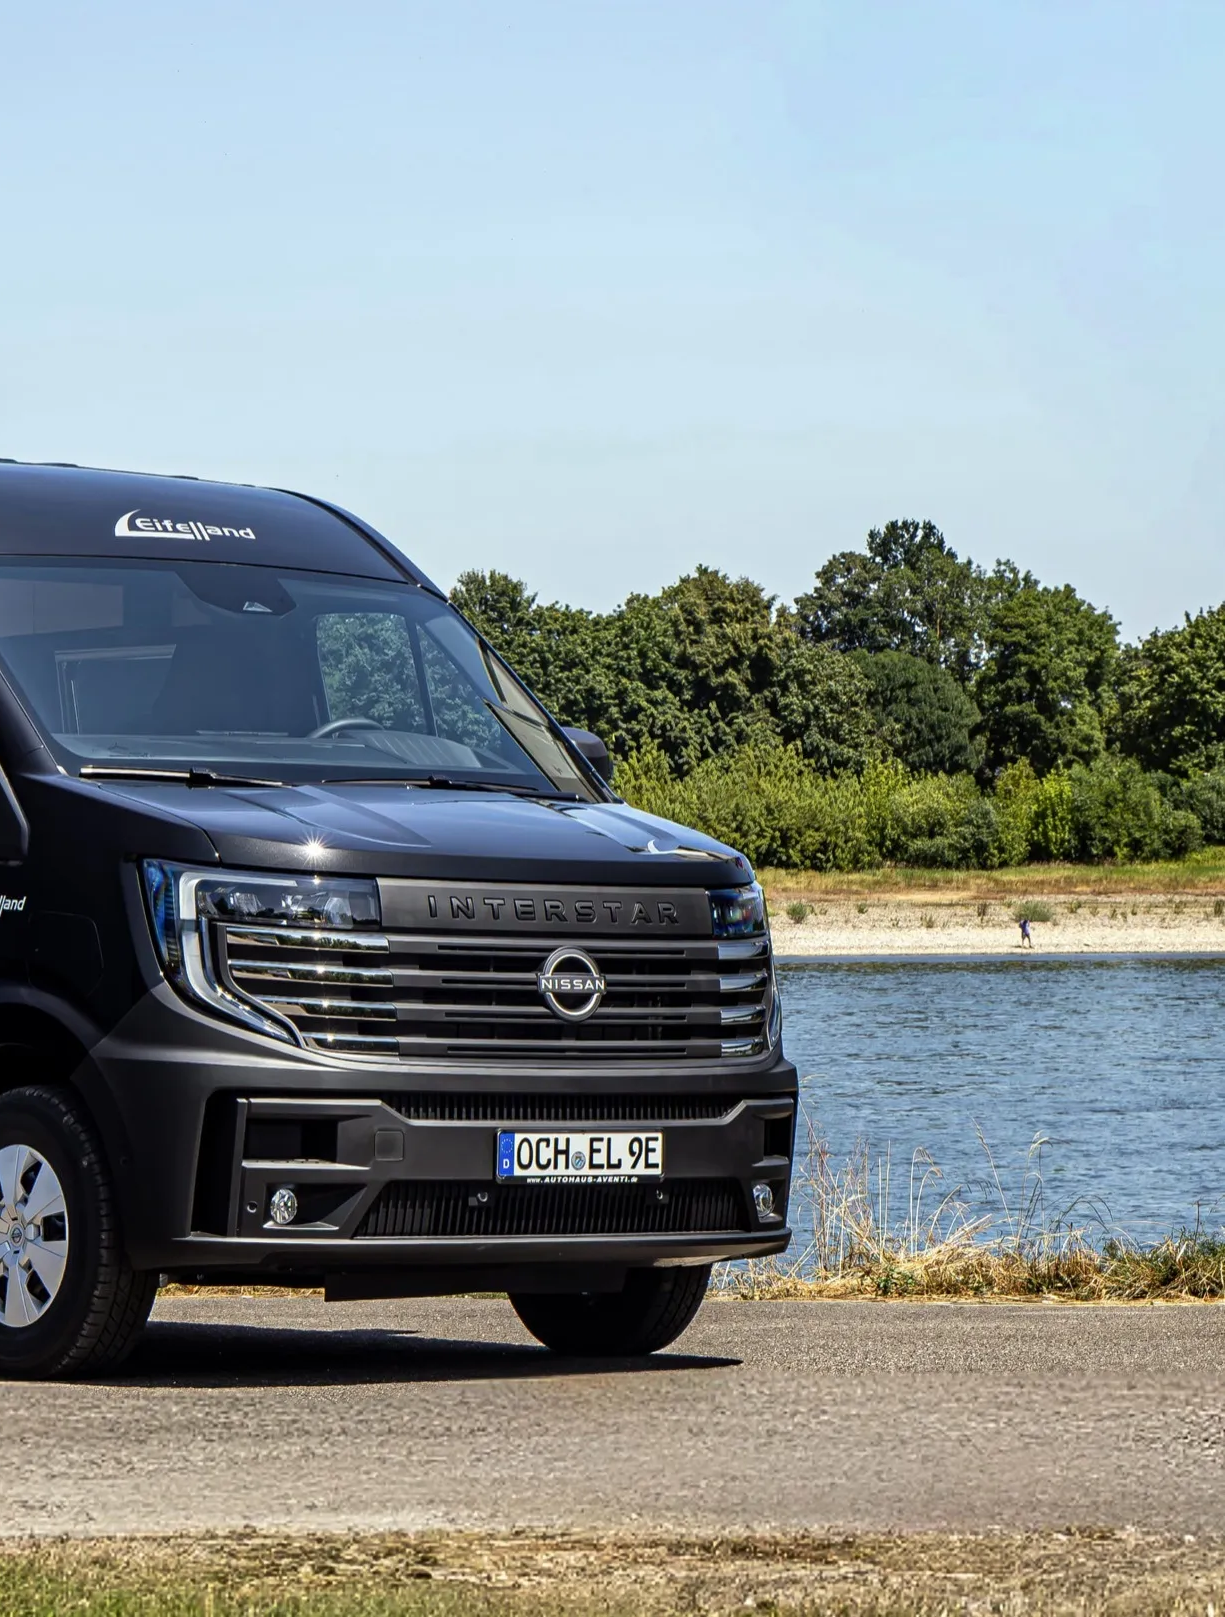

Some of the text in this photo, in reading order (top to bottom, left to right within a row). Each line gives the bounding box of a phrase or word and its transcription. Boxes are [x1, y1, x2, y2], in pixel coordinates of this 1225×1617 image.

[135, 517, 256, 541] Eifelland
[427, 895, 679, 925] INTERSTAR
[541, 979, 605, 990] NISSAN
[516, 1136, 660, 1170] OCH EL 9E
[503, 1159, 510, 1169] D
[526, 1176, 638, 1184] www.AUTOHAUS-AVENTI.de
